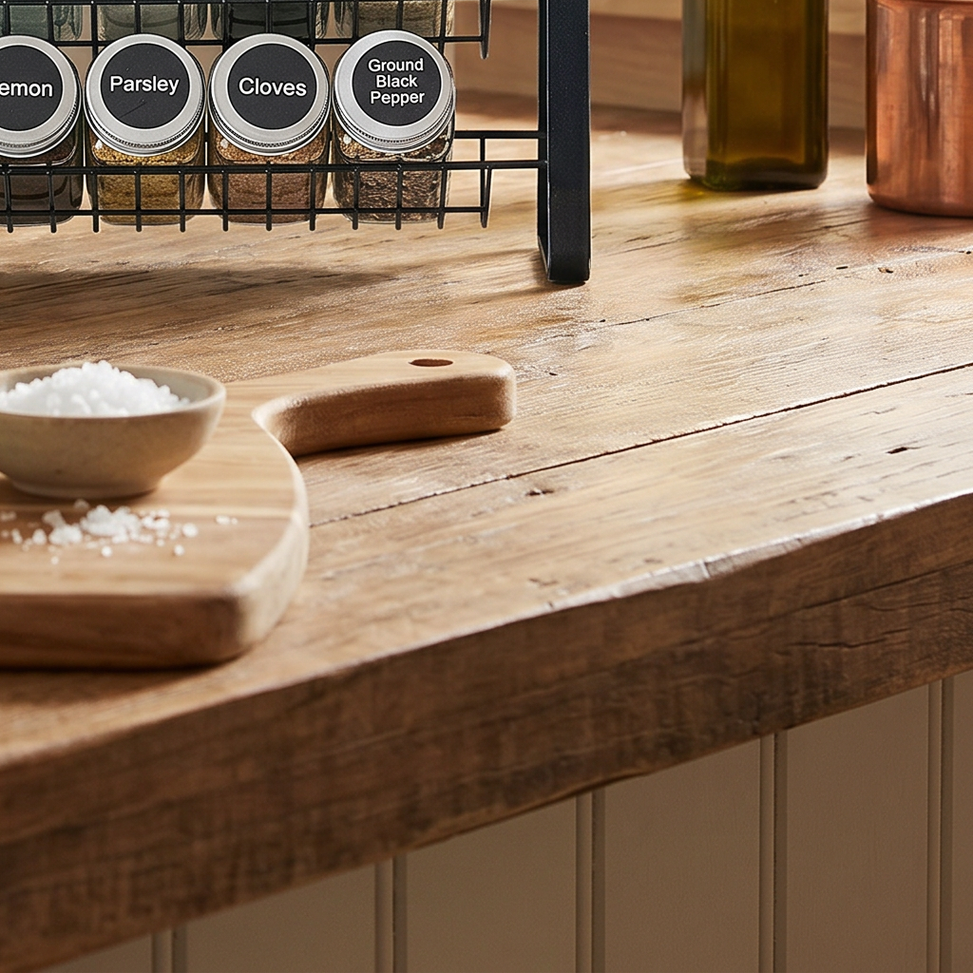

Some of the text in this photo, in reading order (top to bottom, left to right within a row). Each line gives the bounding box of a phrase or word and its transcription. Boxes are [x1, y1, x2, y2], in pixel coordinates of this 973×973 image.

[368, 57, 424, 72] Ground
[110, 75, 180, 96] Parsley
[238, 77, 307, 97] Cloves
[376, 74, 418, 88] Black
[370, 90, 426, 107] Pepper
